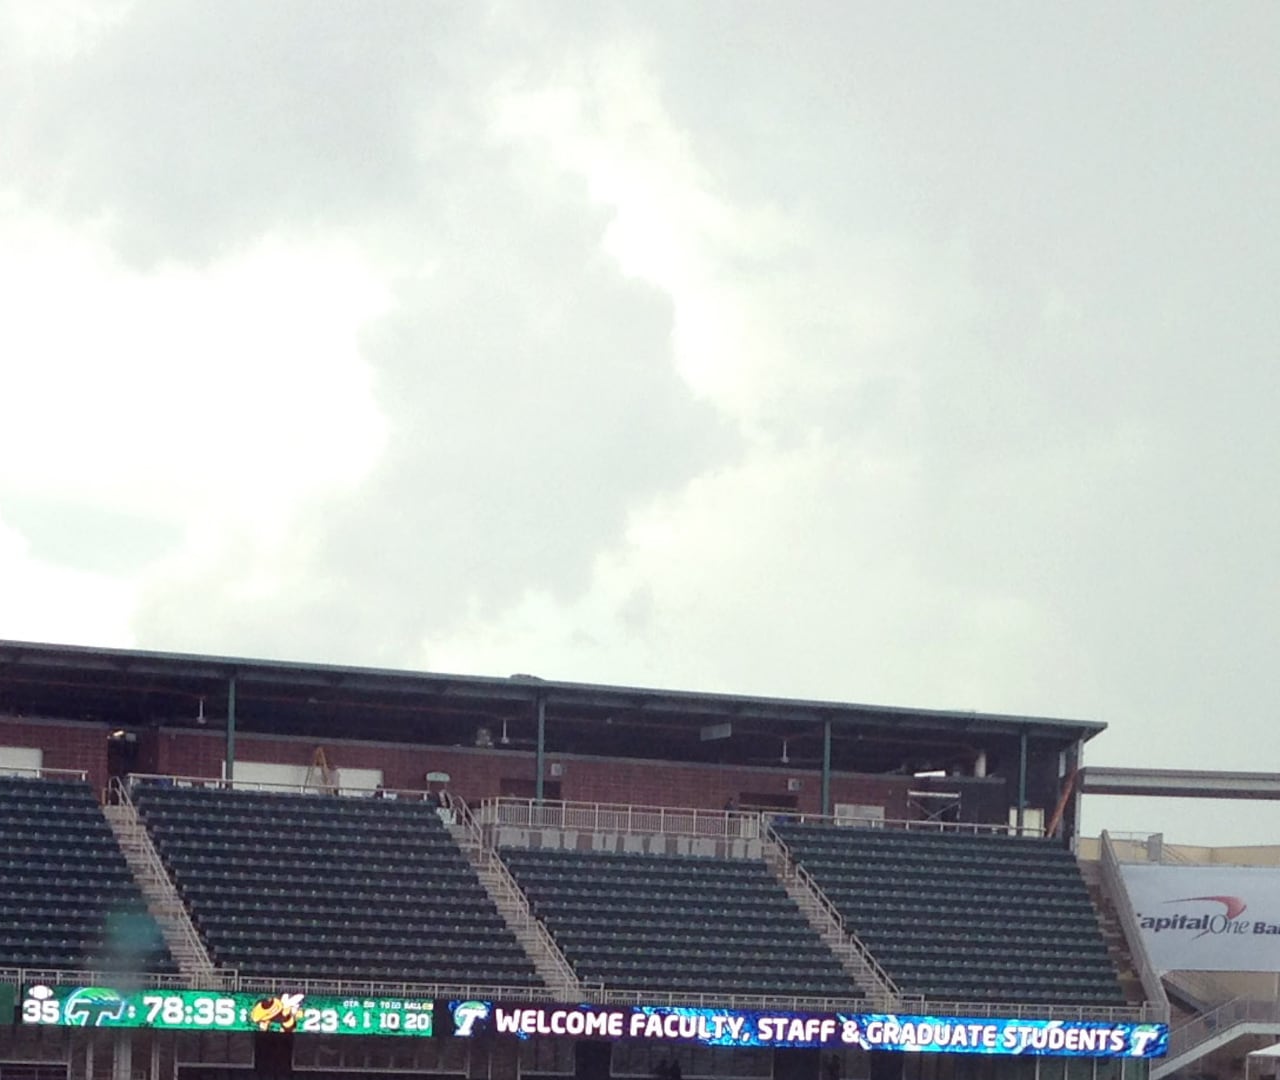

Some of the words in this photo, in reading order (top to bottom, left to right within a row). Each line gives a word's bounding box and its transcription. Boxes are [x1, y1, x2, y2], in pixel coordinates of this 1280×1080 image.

[1136, 913, 1251, 937] apitalOne
[22, 999, 60, 1024] 35
[143, 997, 236, 1026] 78:35
[303, 1009, 339, 1032] 23
[342, 1011, 357, 1028] 4
[363, 1011, 372, 1029] 1
[379, 1012, 400, 1030] 10
[404, 1013, 430, 1031] 20
[496, 1008, 622, 1036] WELCOME
[630, 1013, 750, 1042] FACULTY,
[758, 1017, 835, 1043] STAFF
[841, 1020, 861, 1044] &
[866, 1021, 997, 1047] GRADUATE
[1003, 1026, 1124, 1050] STUDENTS
